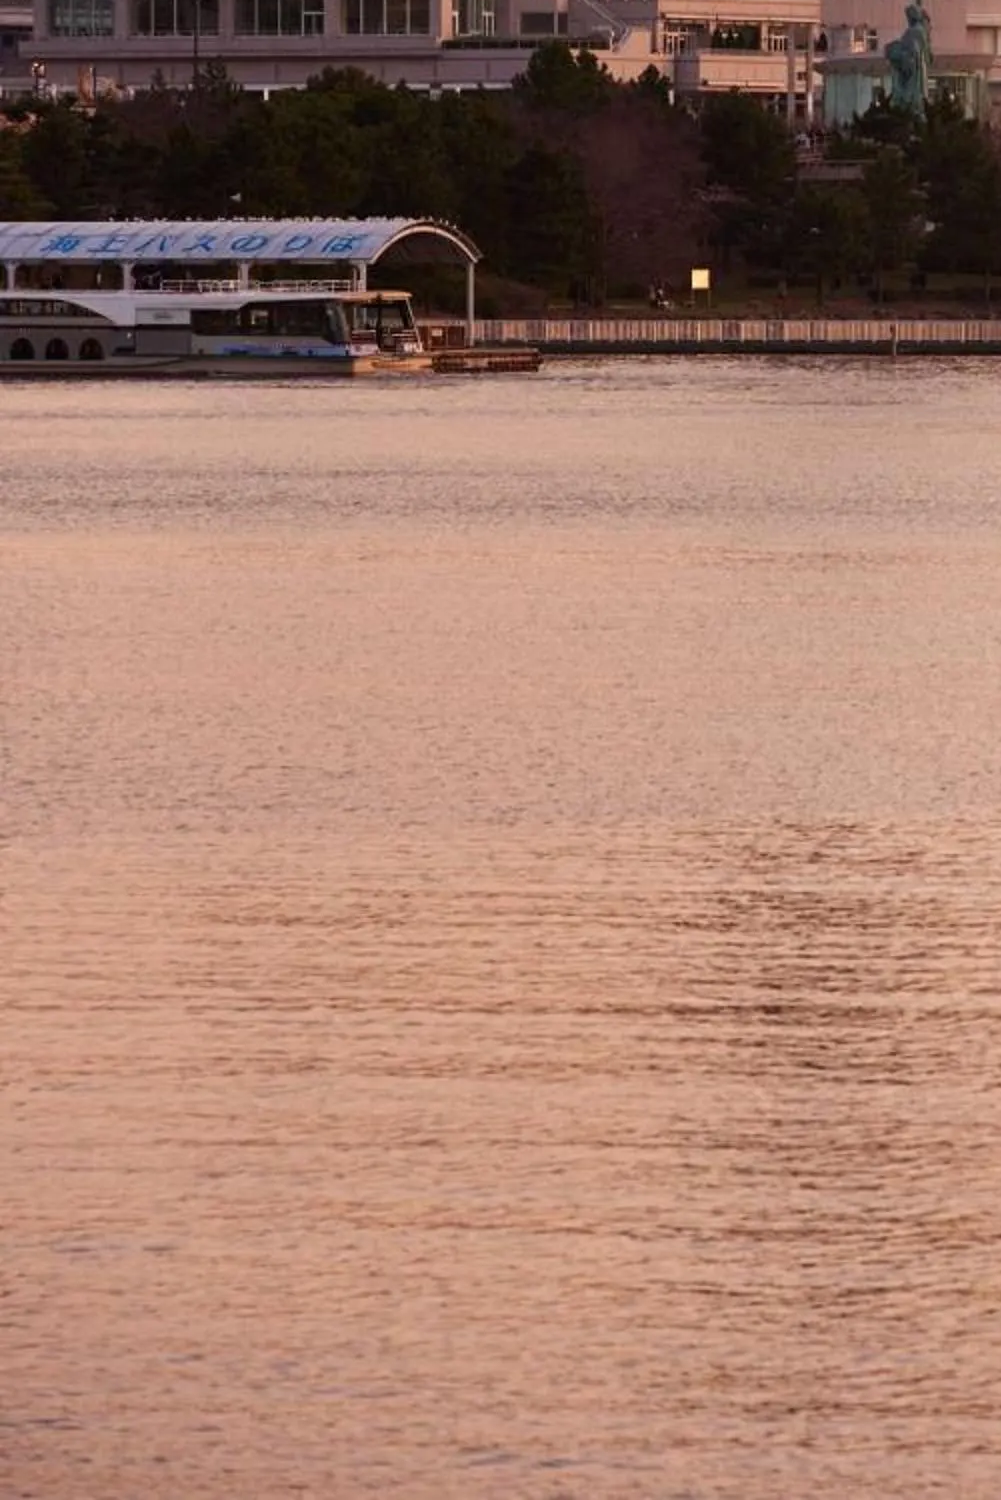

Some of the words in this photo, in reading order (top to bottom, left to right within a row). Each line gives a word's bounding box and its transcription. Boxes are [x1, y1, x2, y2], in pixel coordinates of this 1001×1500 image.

[40, 234, 368, 253] 海上バスのりば
